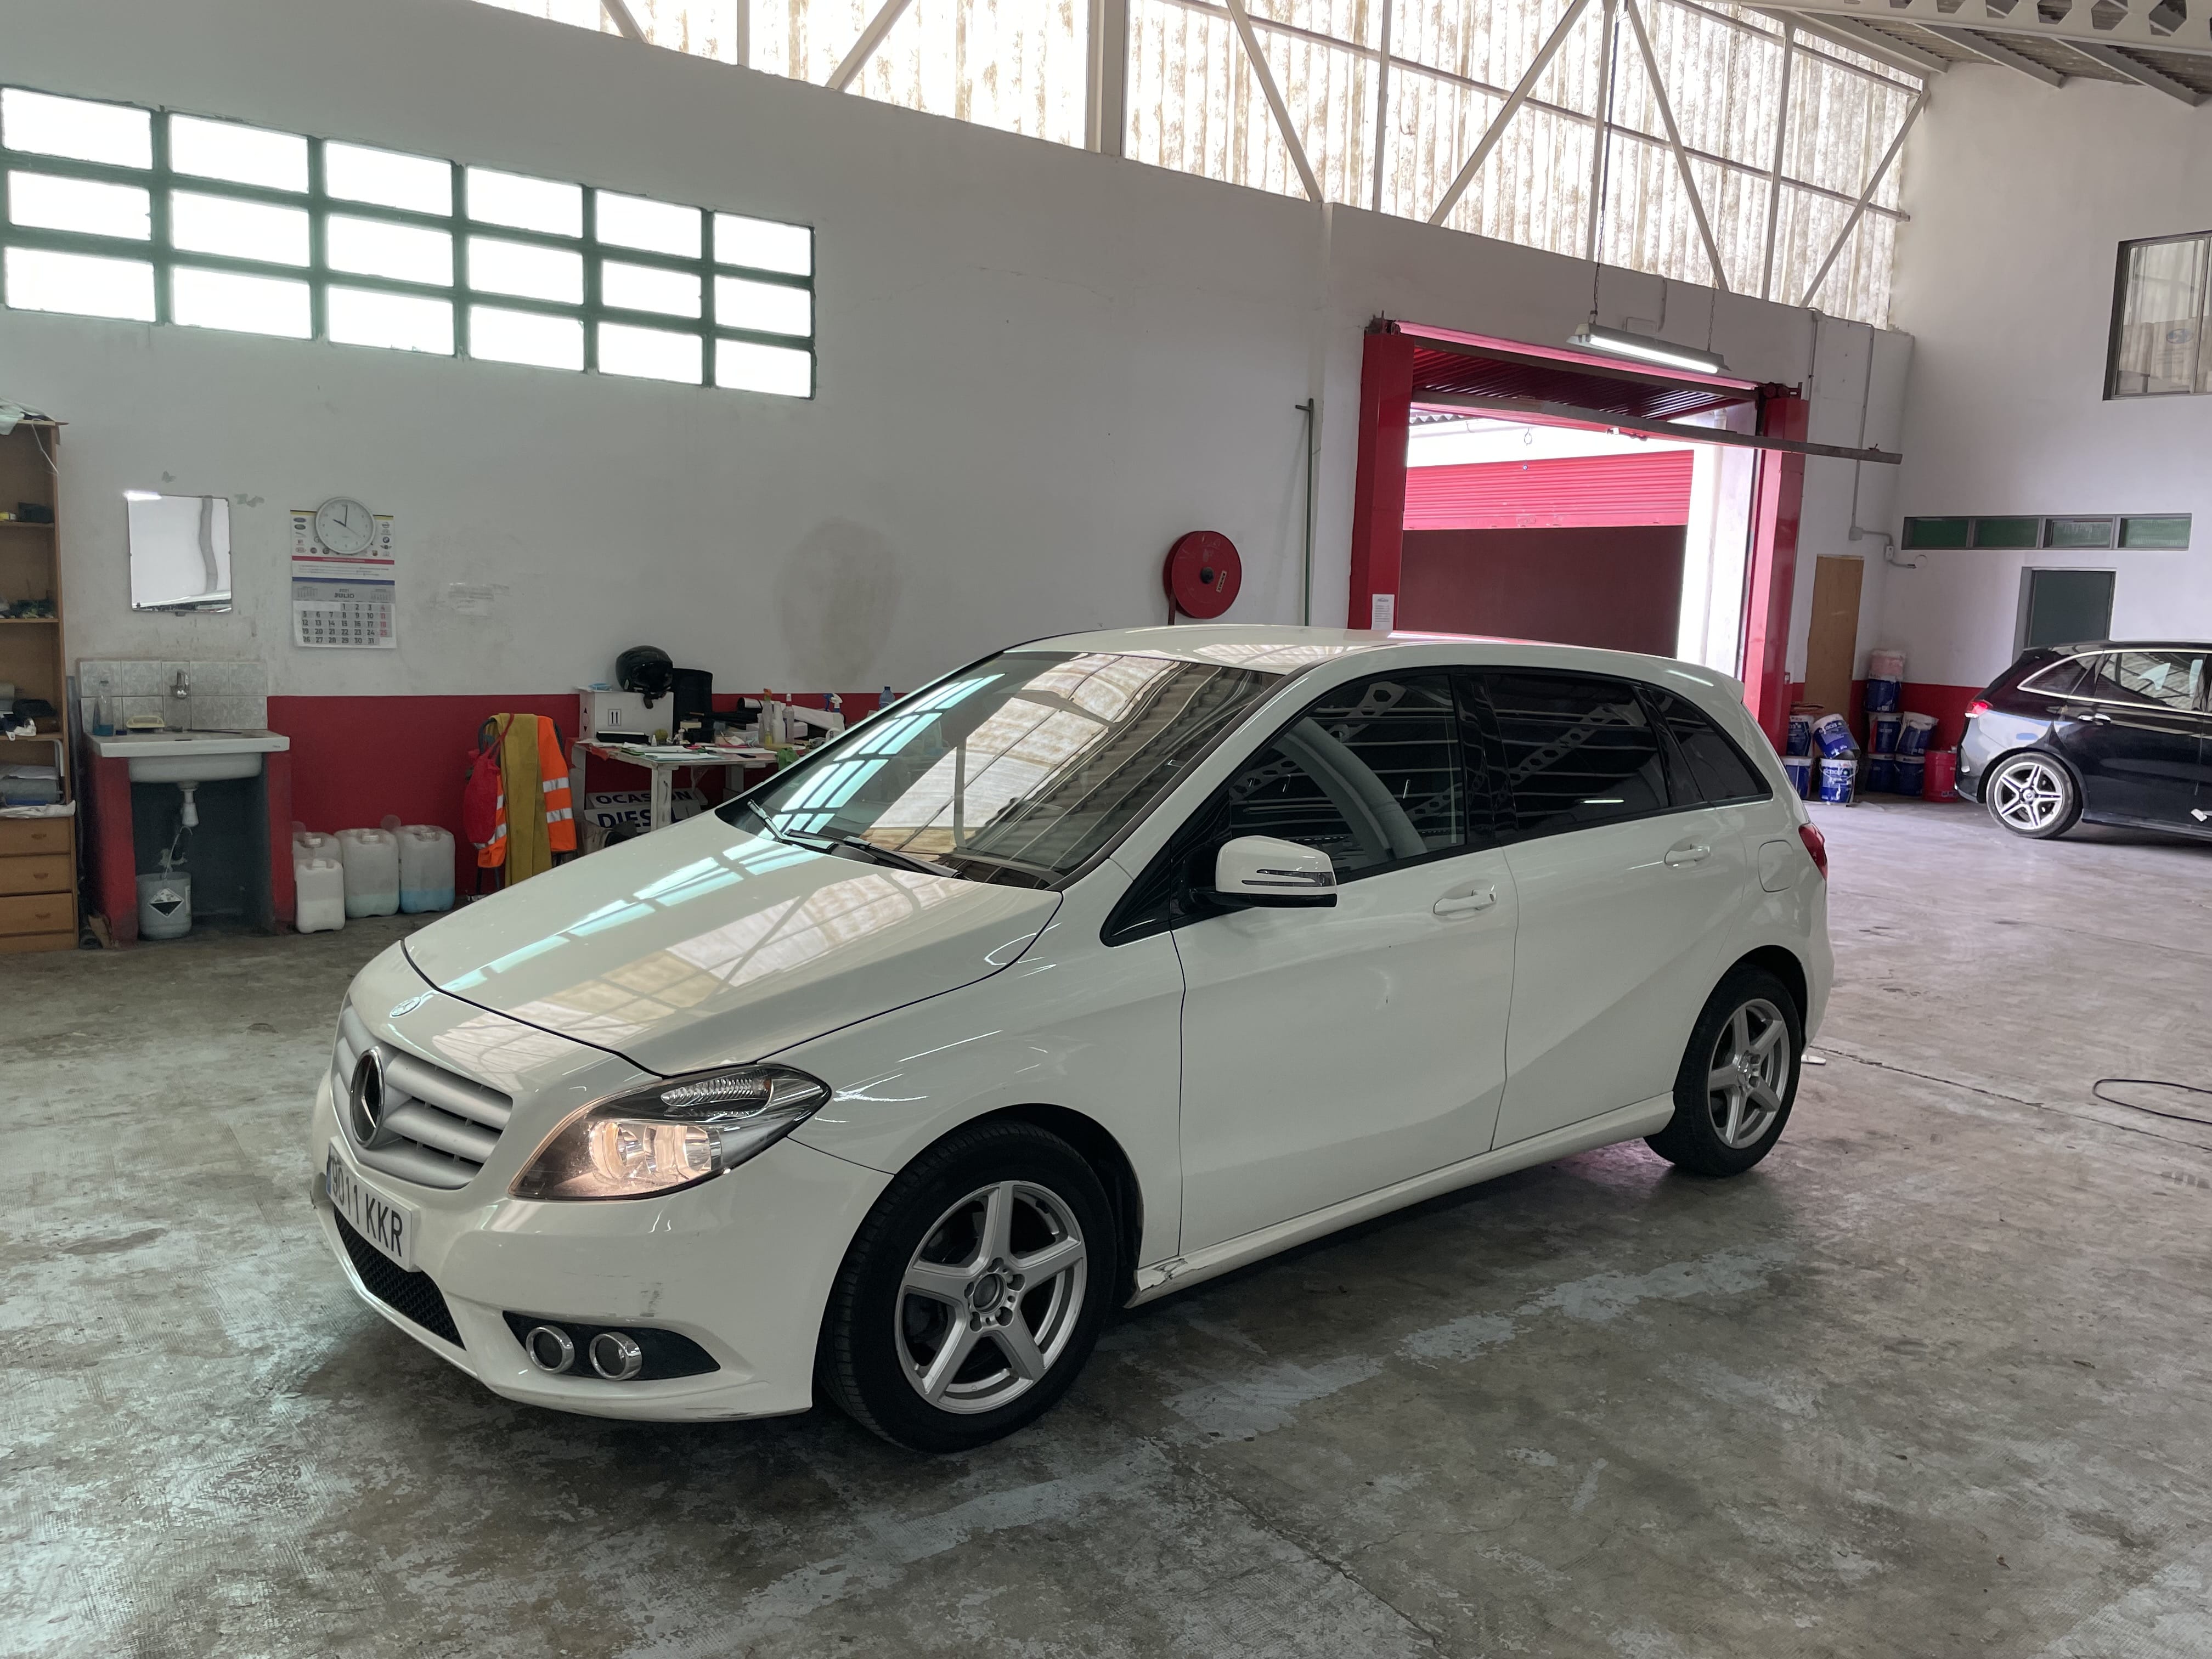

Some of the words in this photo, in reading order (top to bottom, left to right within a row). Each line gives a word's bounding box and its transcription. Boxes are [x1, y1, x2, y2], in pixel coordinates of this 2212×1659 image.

[596, 791, 693, 804] OCASN
[597, 808, 683, 828] DIESL
[332, 1158, 359, 1225] 9011
[365, 1193, 403, 1257] KKR
